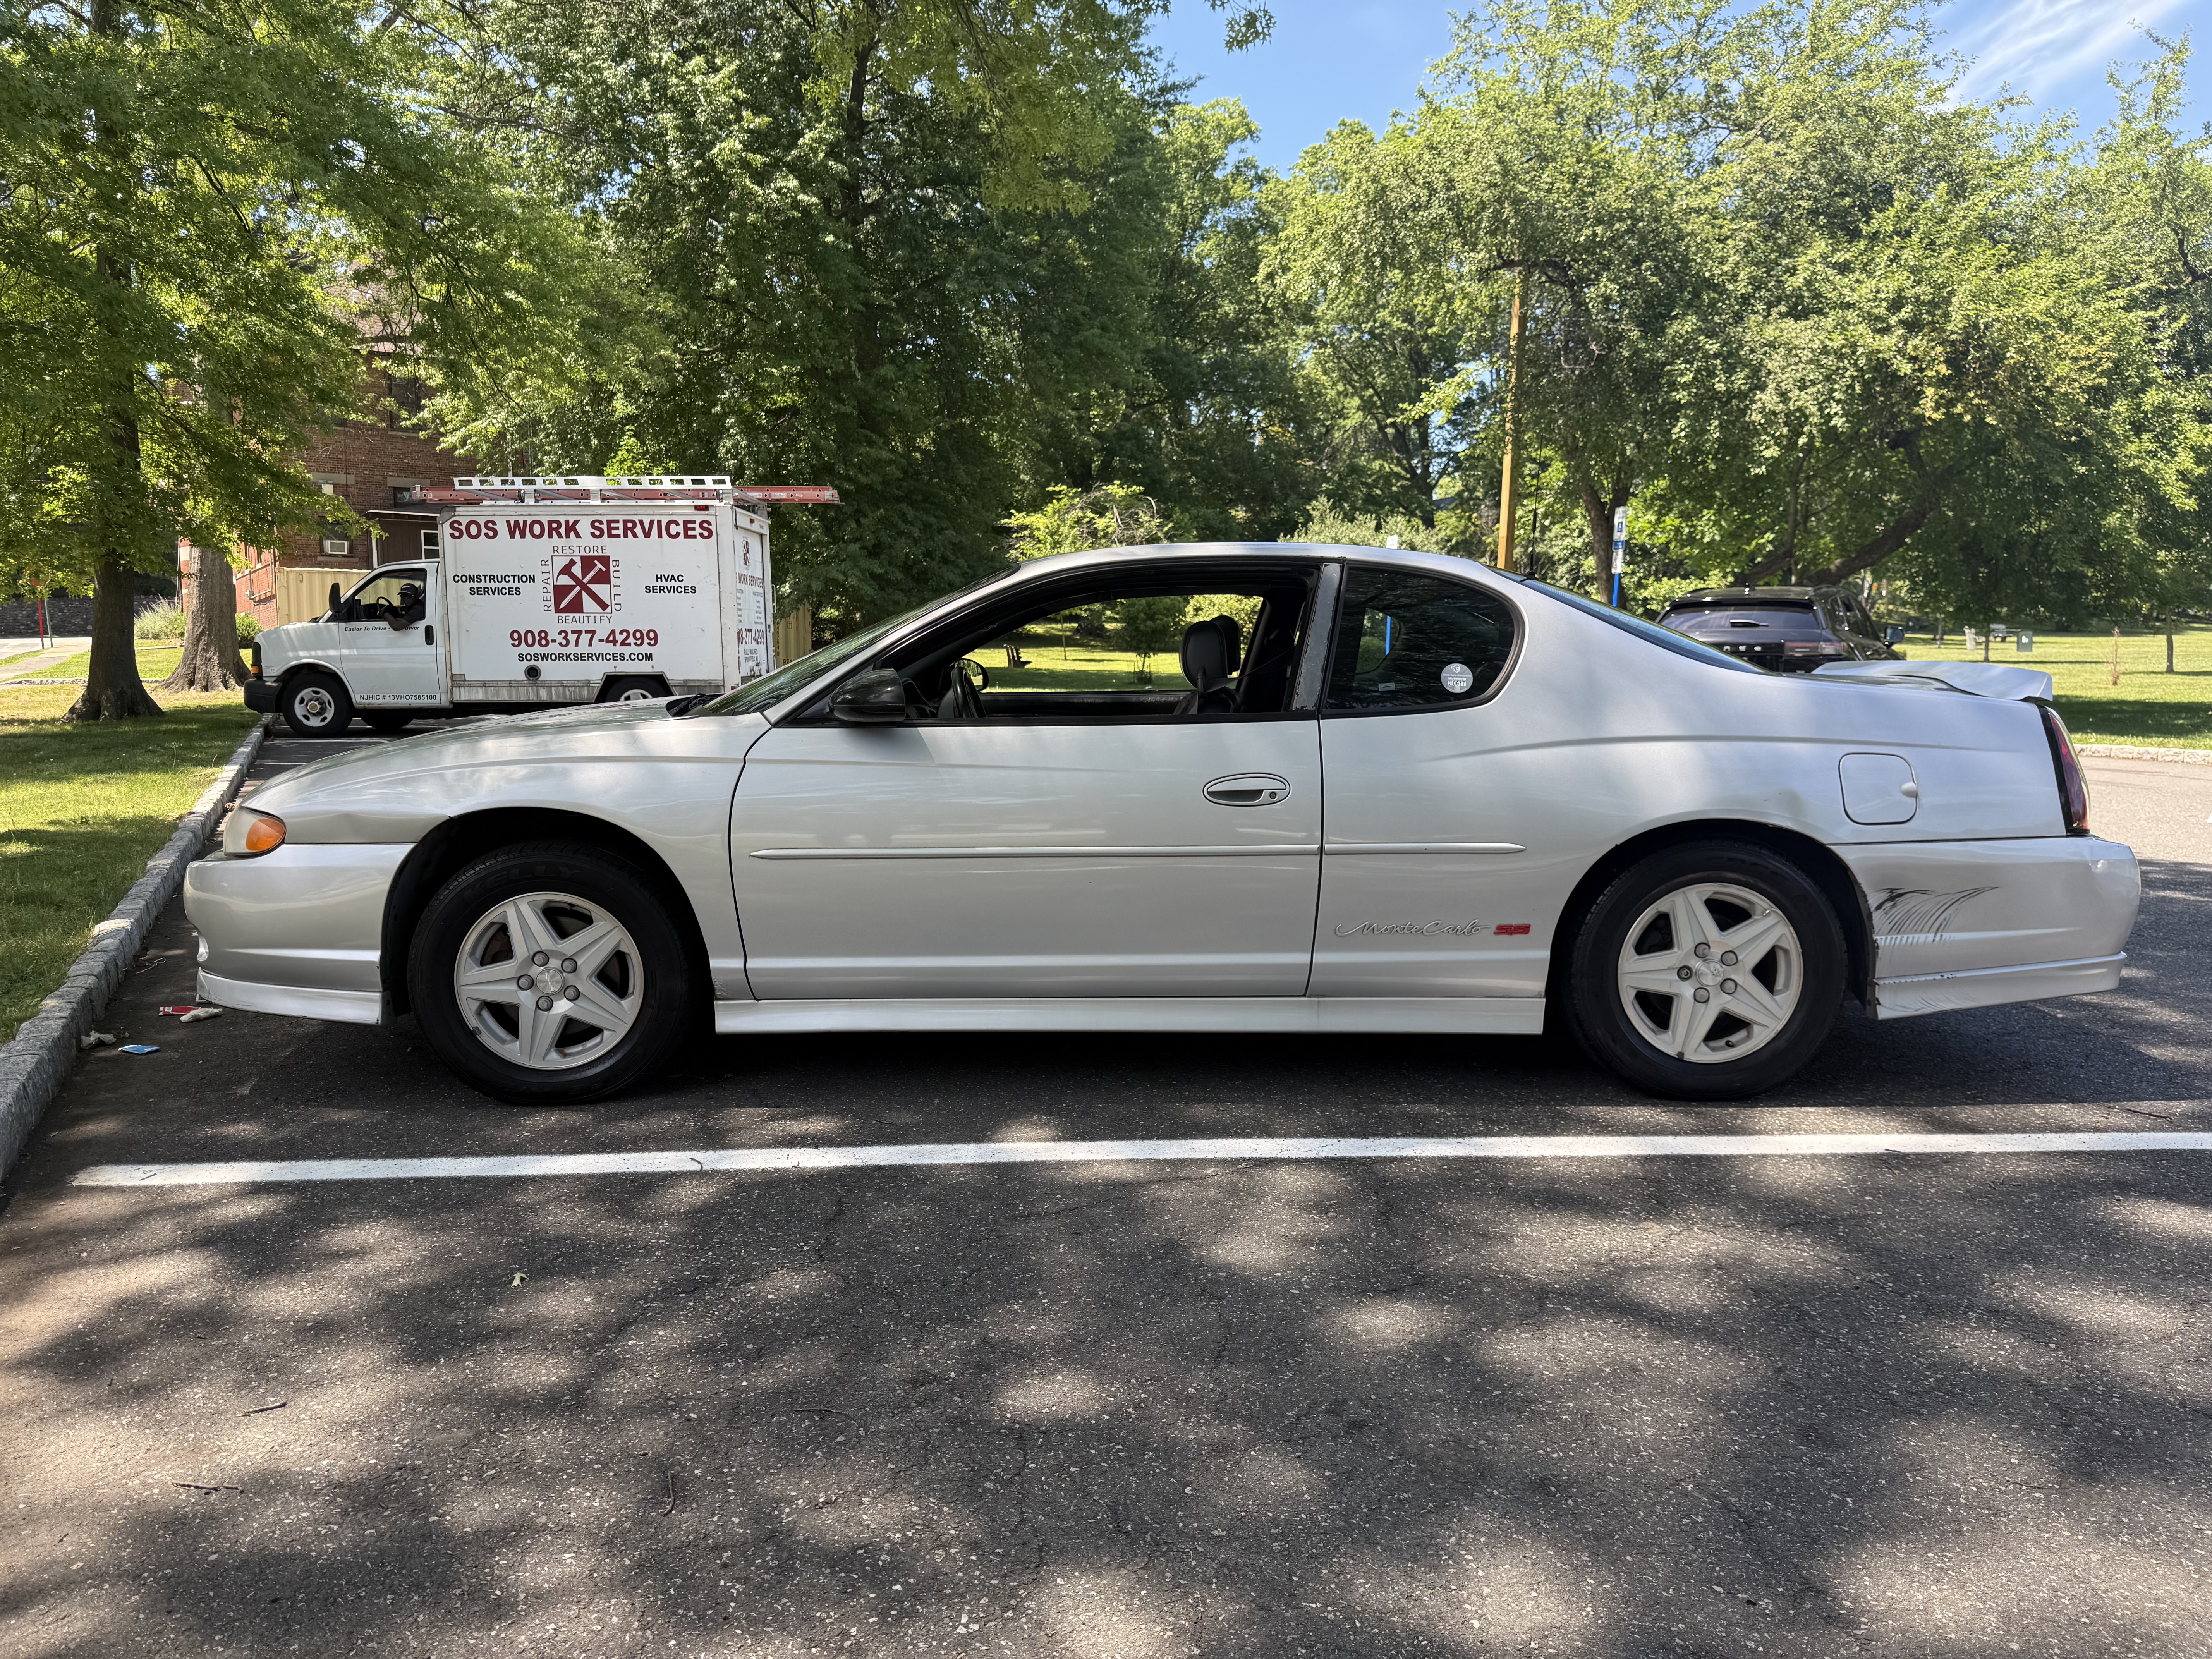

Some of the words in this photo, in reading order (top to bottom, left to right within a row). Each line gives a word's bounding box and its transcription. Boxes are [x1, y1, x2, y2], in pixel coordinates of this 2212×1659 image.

[449, 520, 498, 539] SOS
[506, 519, 582, 539] WORK
[590, 519, 713, 539] SERVICES
[553, 546, 607, 554] RESTORE
[453, 574, 535, 583] CONSTRUCTION
[656, 574, 684, 582] HVAC
[541, 559, 552, 611] REPAIR
[612, 560, 622, 611] BUILD
[469, 587, 521, 596] SERVICES
[645, 586, 696, 594] SERVICES
[558, 615, 612, 624] BEAUTIFY
[510, 629, 658, 647] 908-377-4299
[518, 653, 653, 662] SOSWORKSERVICES.COM
[1494, 924, 1531, 936] SS
